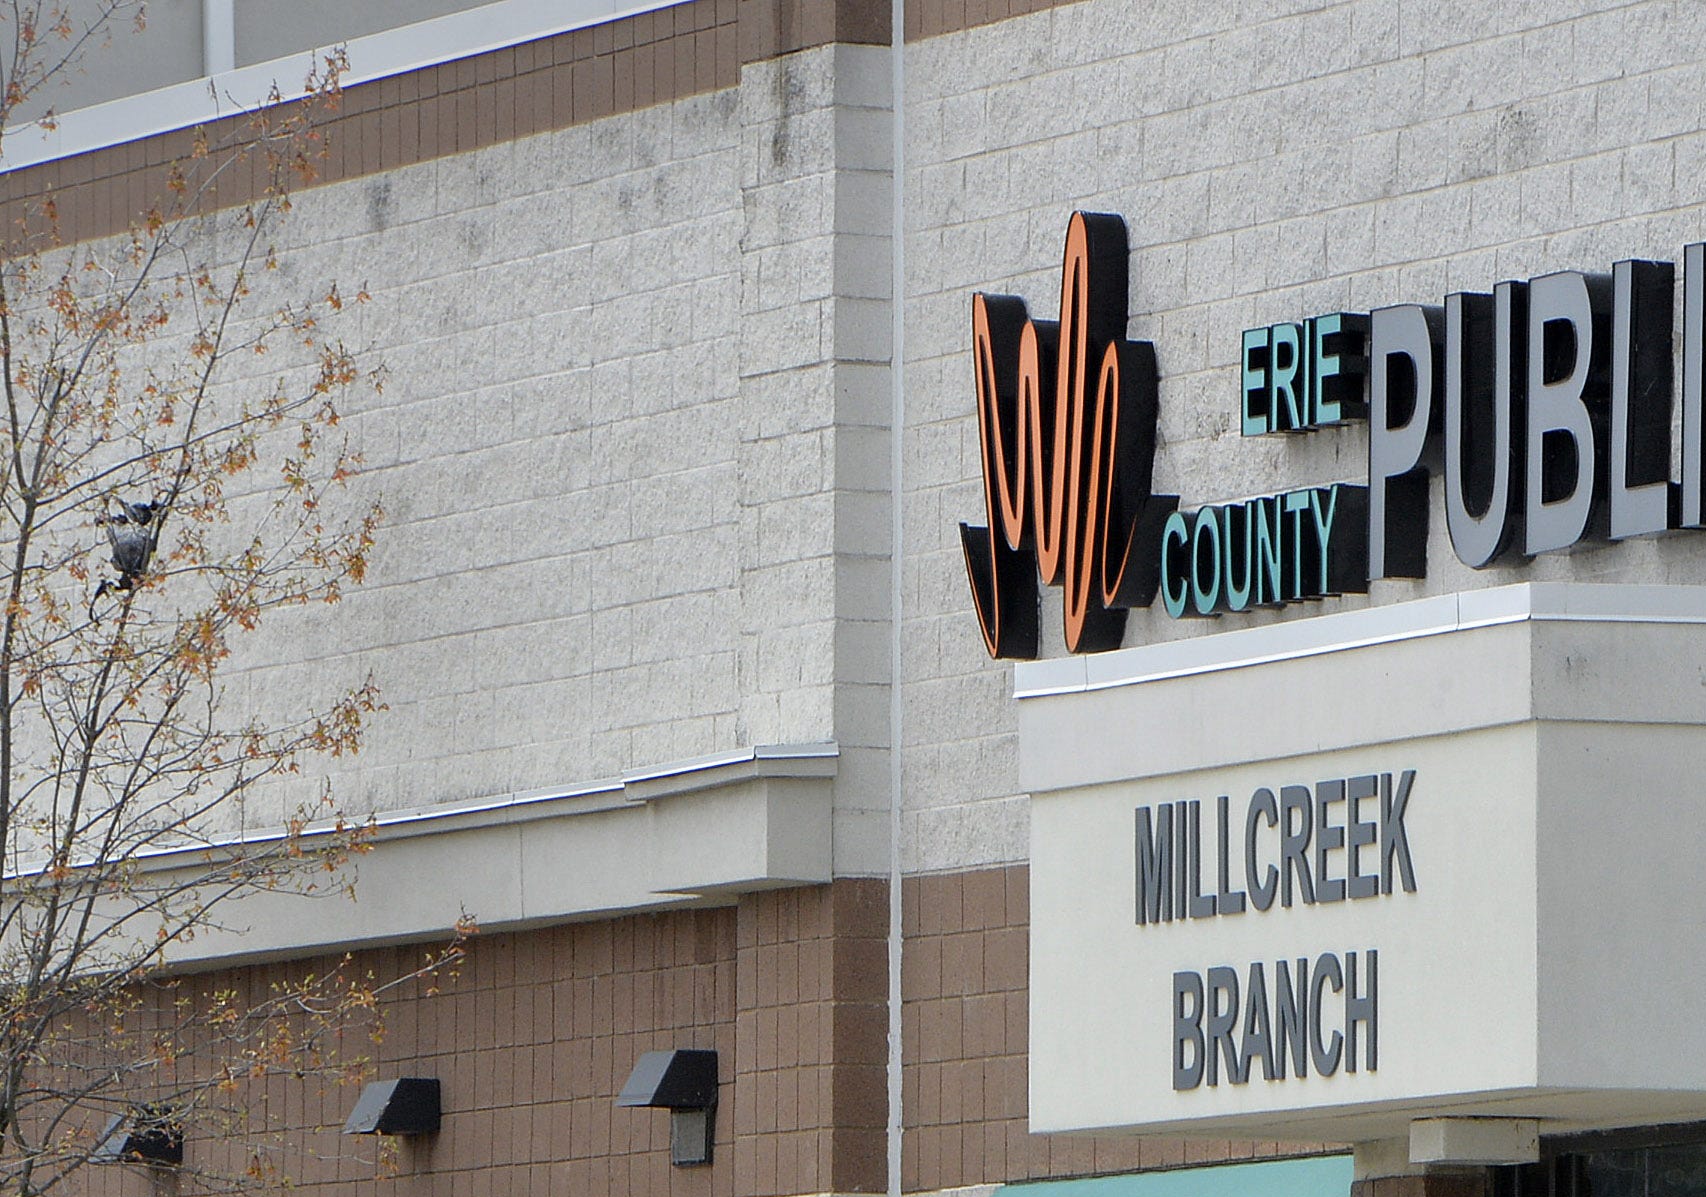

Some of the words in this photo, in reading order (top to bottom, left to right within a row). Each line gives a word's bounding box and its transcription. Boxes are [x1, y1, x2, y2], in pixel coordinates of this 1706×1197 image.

[1241, 313, 1342, 437] ERIE
[1160, 484, 1339, 619] COUNTY
[1135, 769, 1417, 926] MILLCREEK
[1172, 949, 1379, 1091] BRANCH
